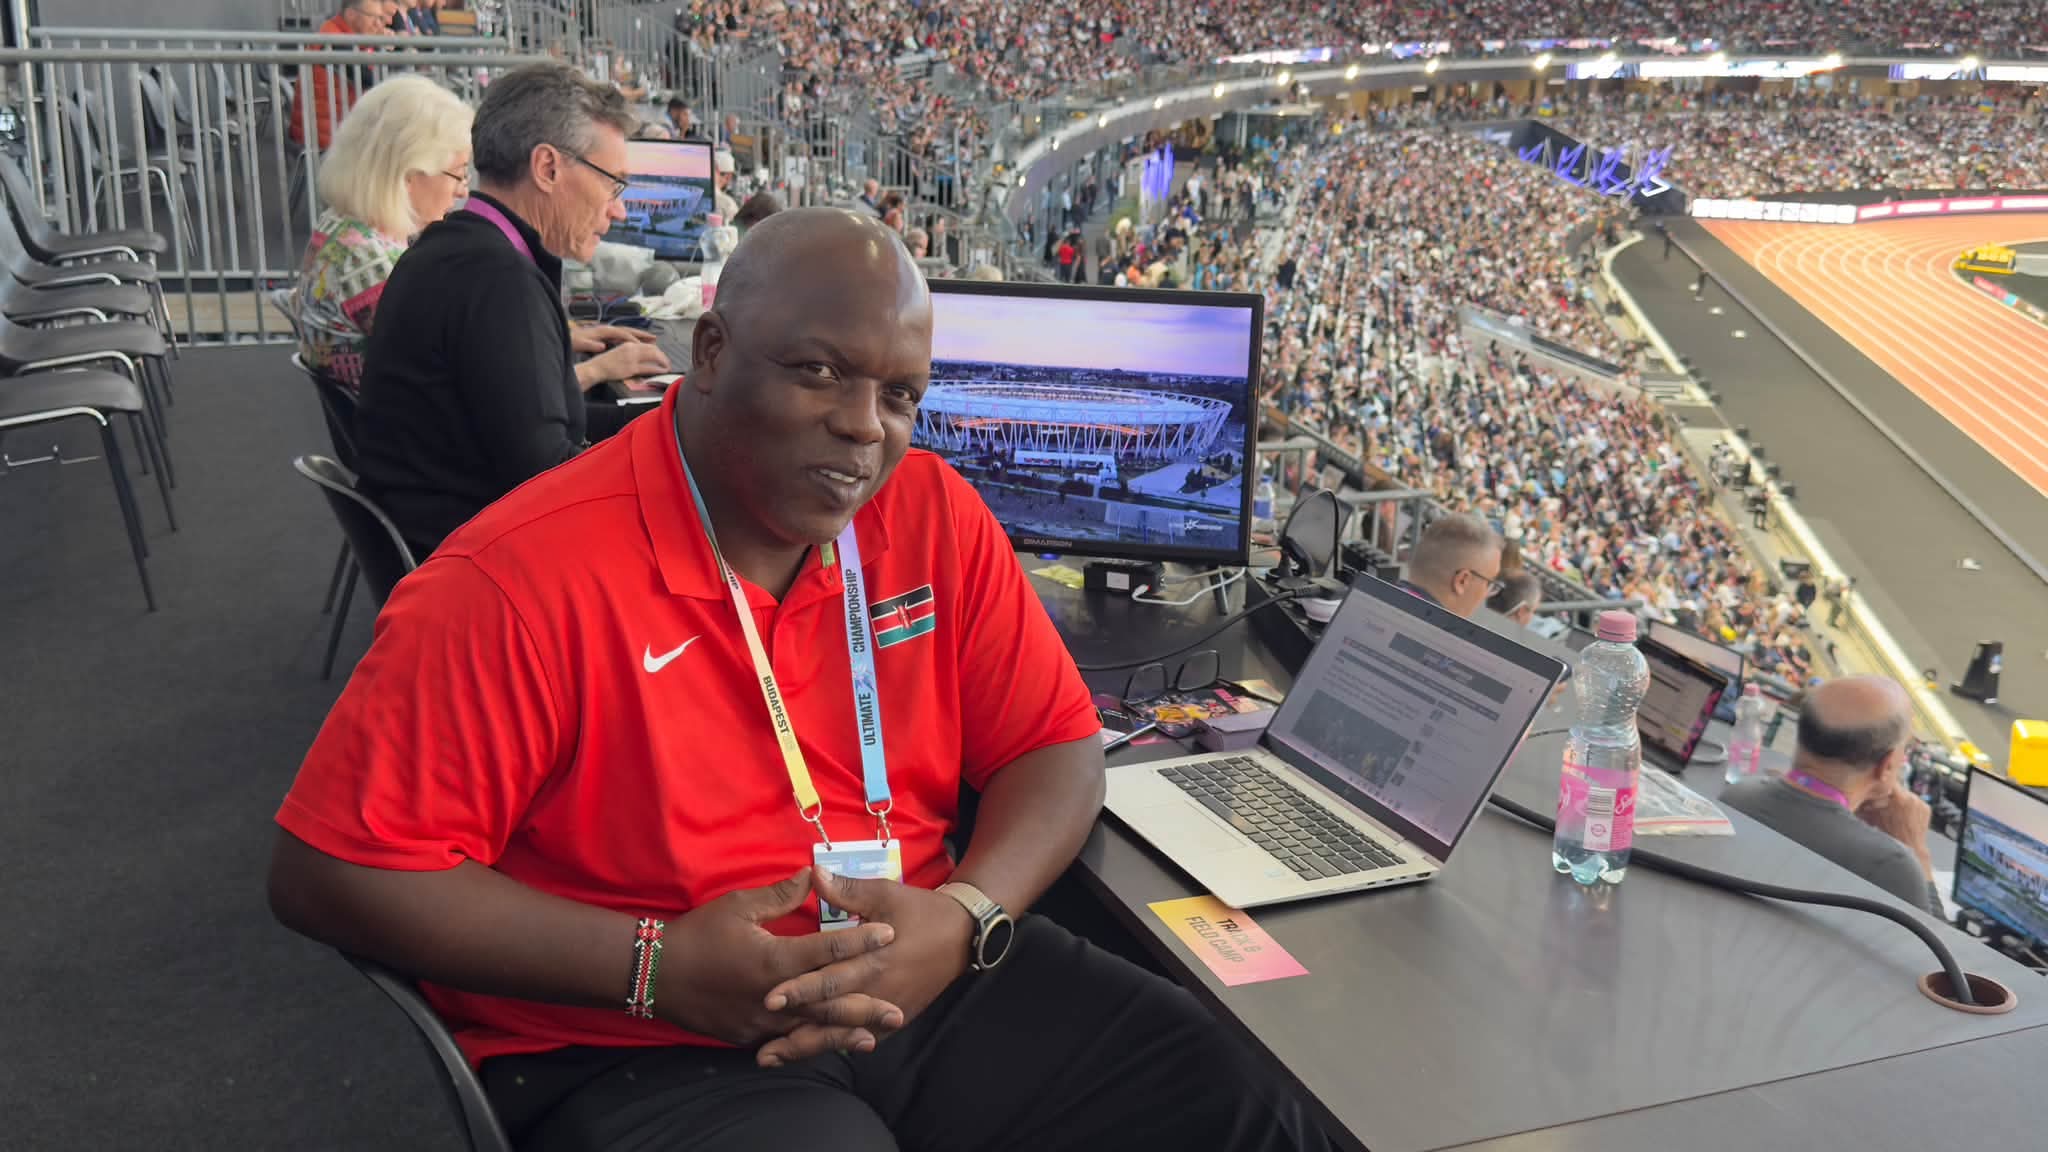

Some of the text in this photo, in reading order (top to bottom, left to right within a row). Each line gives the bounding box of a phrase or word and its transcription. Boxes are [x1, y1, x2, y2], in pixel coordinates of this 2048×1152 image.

[845, 568, 876, 746] ULTIMATE CHAMPIONSHIP
[763, 675, 790, 733] BUDAPEST
[1184, 916, 1245, 962] FIELD CAMP
